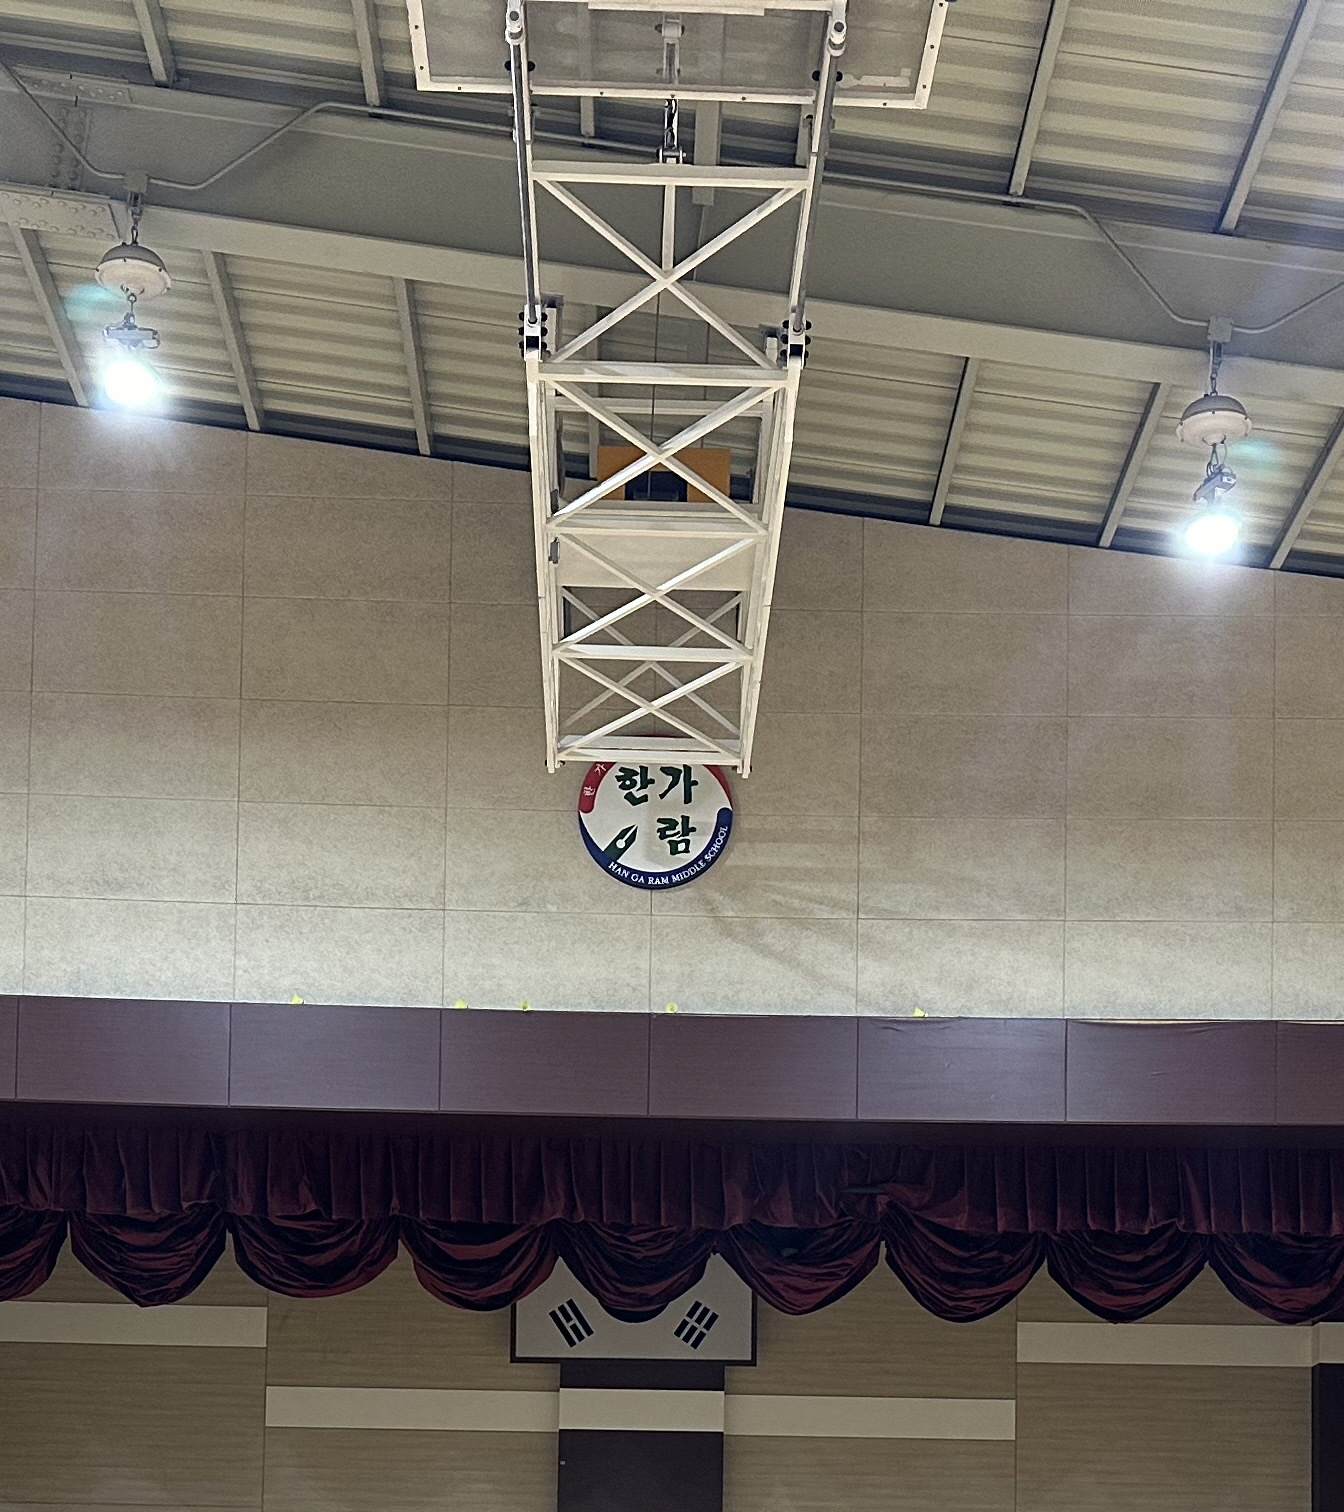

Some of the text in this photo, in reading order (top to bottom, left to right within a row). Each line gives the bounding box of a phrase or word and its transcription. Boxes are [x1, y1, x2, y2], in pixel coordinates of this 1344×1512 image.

[608, 825, 728, 885] HAN GA RAM MIDDLE SCHOOL
[657, 815, 697, 856] 람
